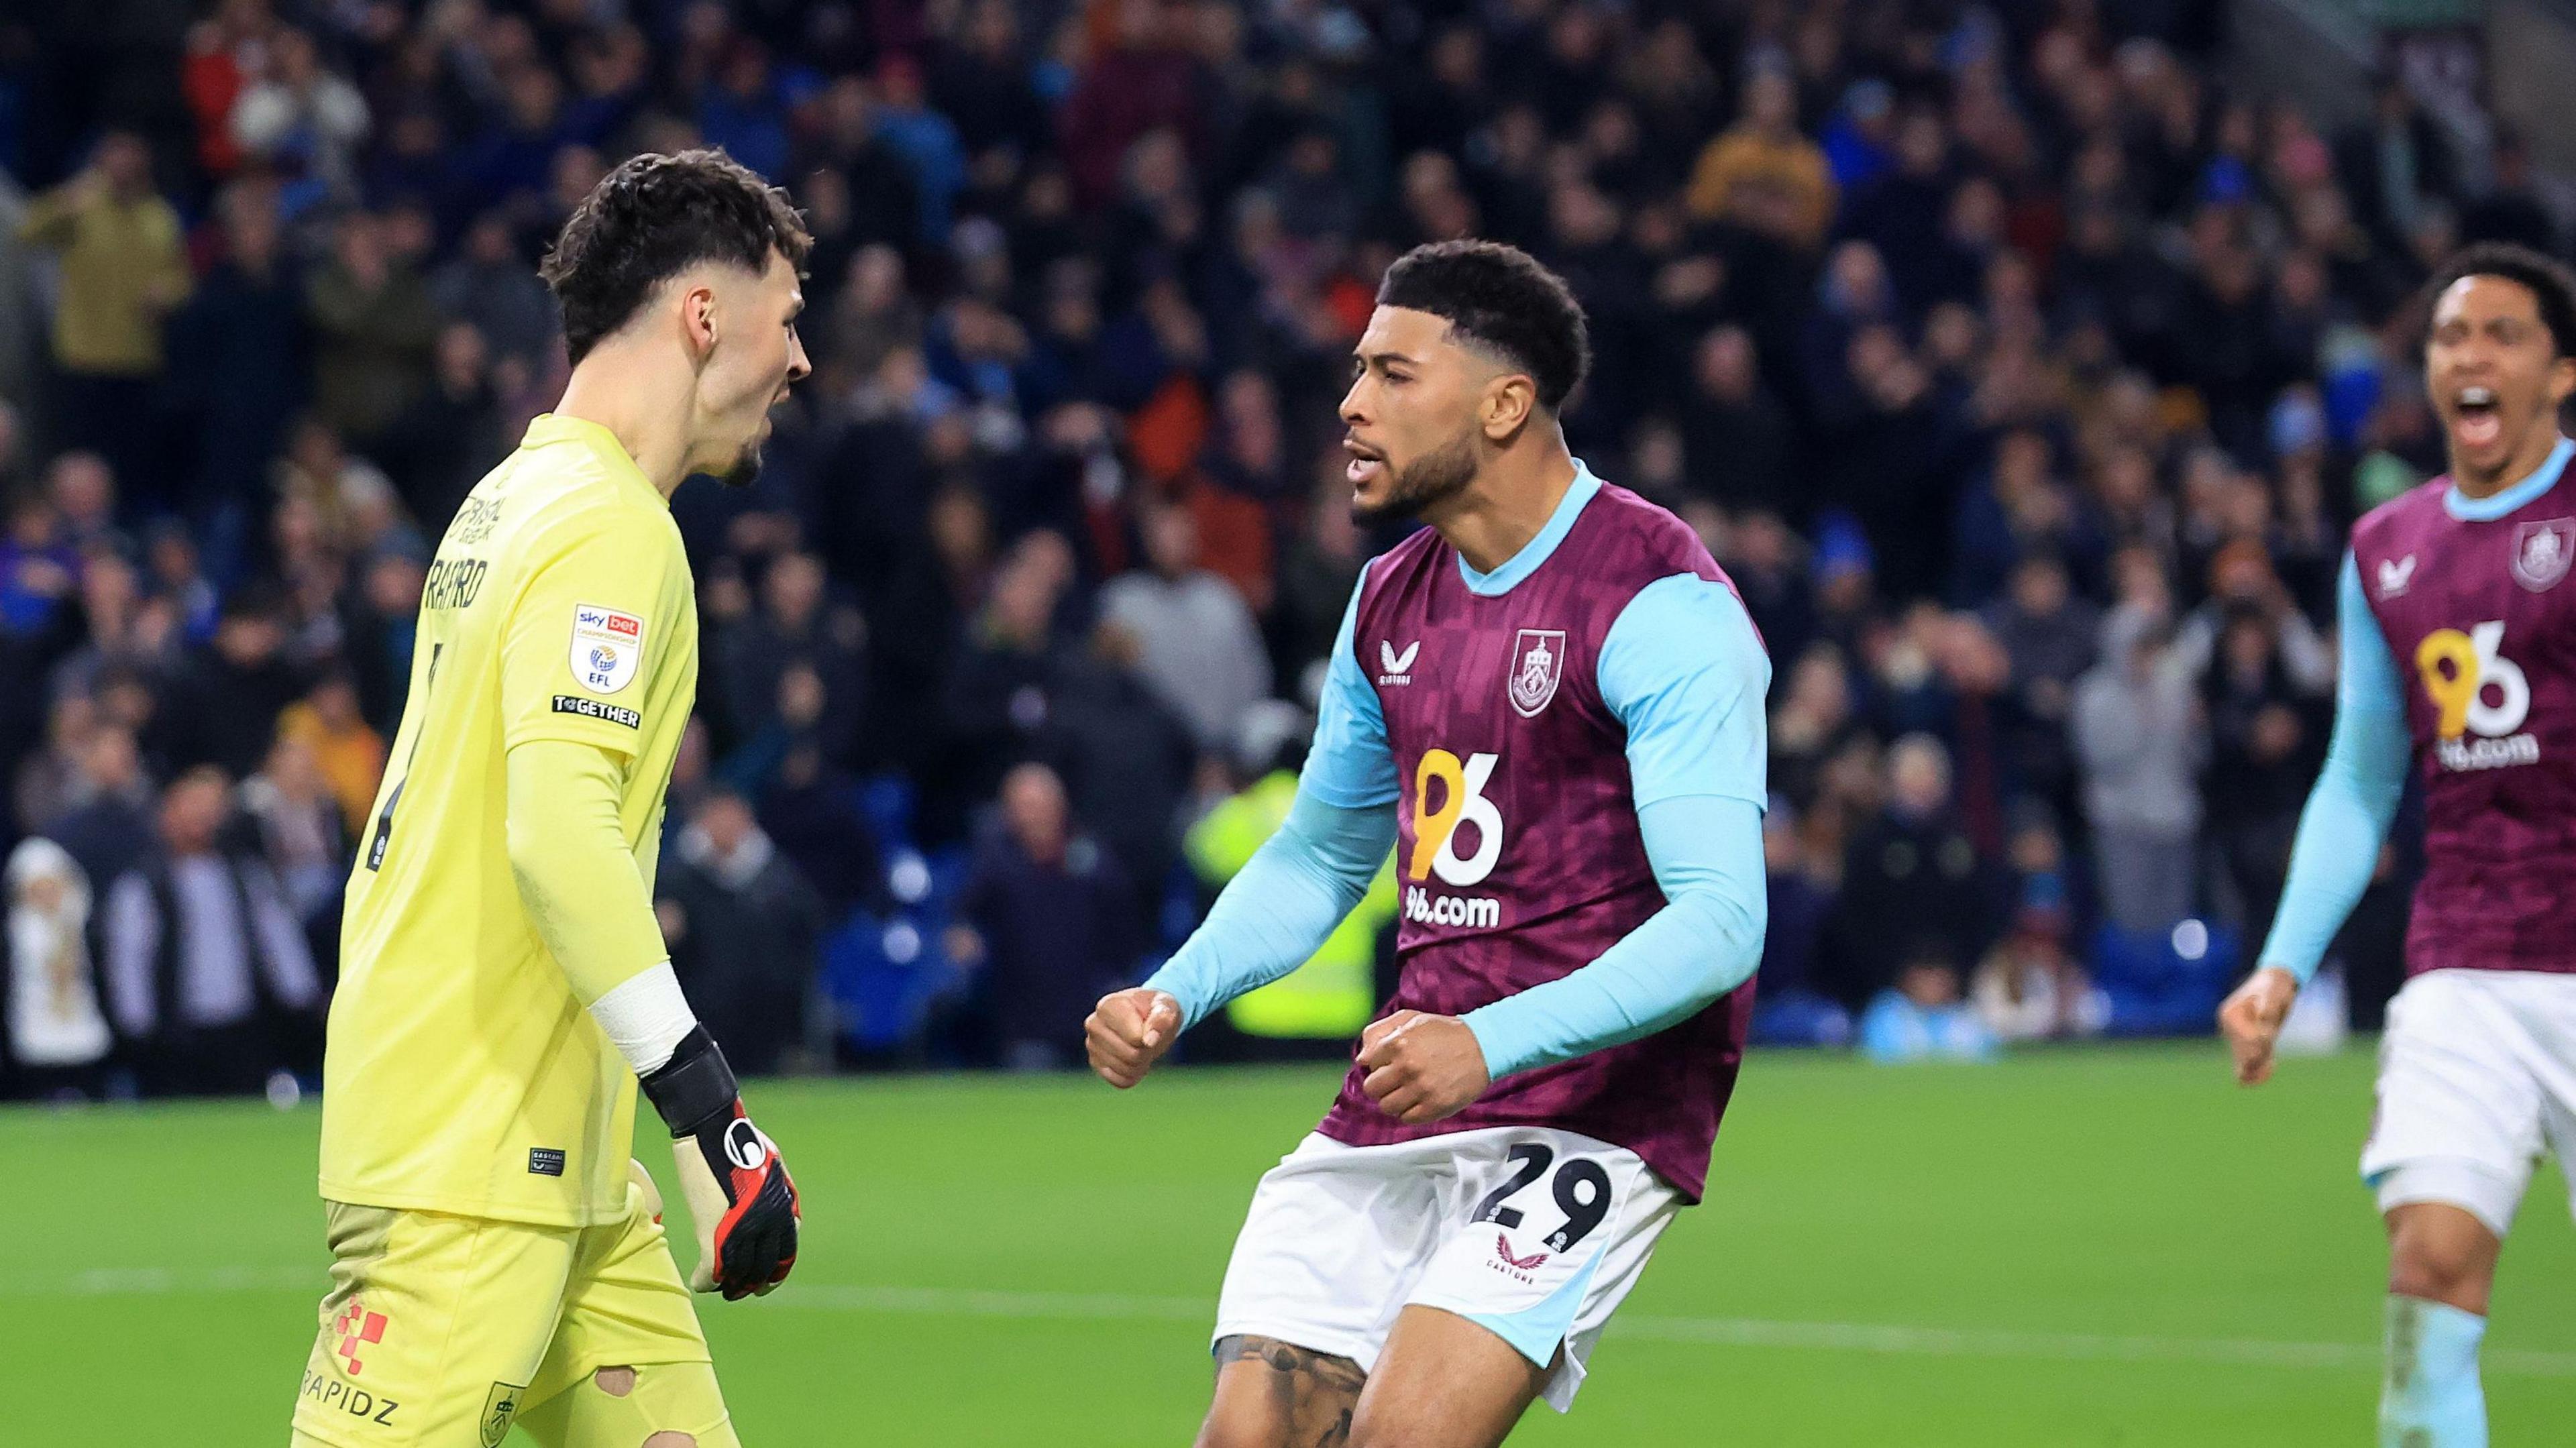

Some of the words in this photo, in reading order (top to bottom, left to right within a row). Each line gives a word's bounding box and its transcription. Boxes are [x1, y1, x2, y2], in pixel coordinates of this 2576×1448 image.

[580, 612, 606, 627] sky
[610, 616, 636, 634] bet
[589, 672, 610, 687] EFL
[2416, 620, 2530, 741] 96
[1409, 748, 1503, 887] 96
[1406, 885, 1499, 928] 96.com
[1470, 1142, 1612, 1254] 29
[1487, 1259, 1534, 1285] CASTORE
